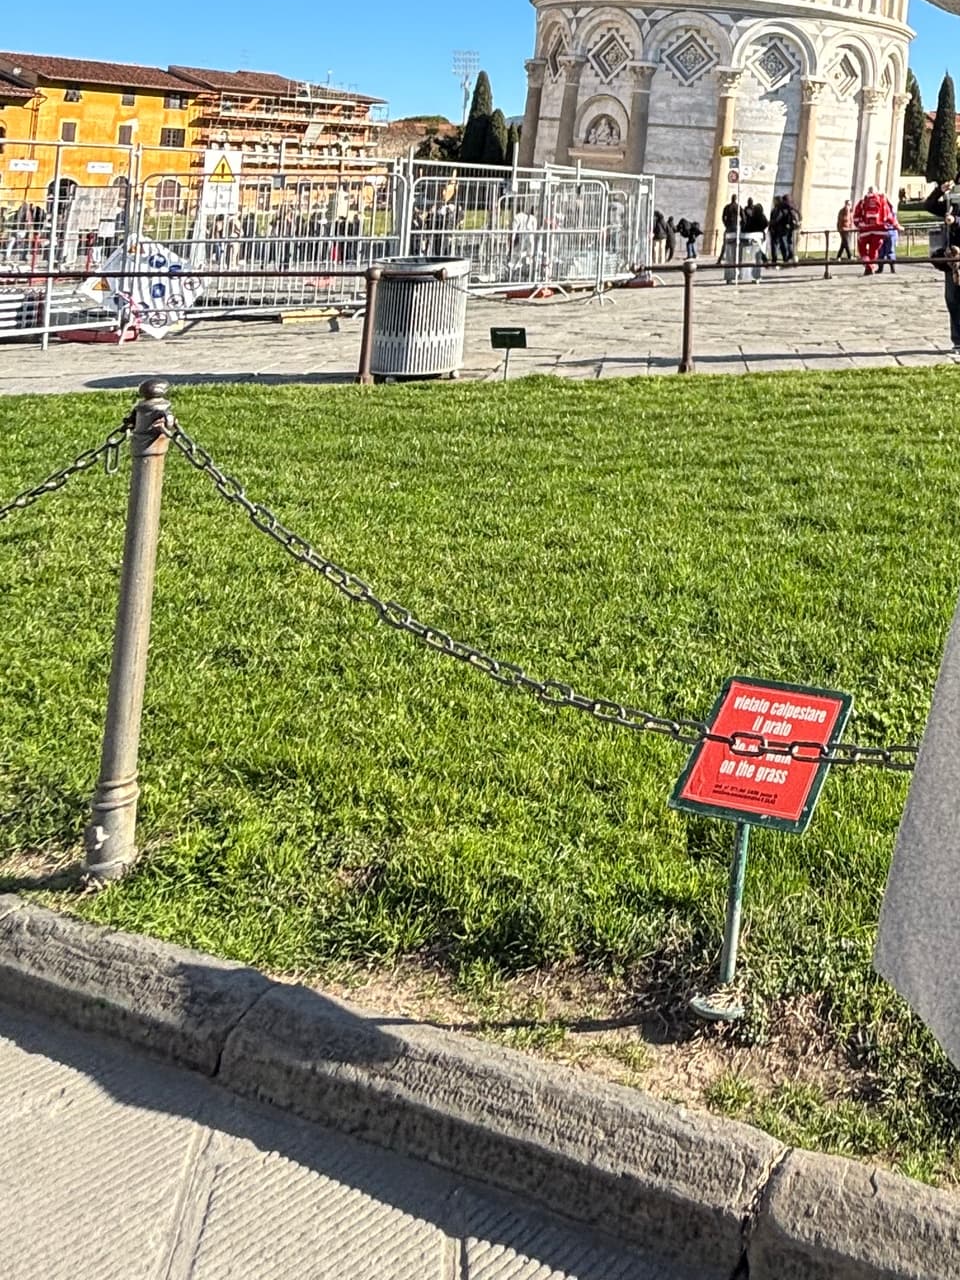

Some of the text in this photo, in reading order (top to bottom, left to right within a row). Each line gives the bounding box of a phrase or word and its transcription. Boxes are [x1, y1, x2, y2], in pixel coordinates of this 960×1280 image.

[734, 695, 827, 723] vietato calpestare
[752, 715, 792, 737] il prato
[720, 759, 788, 784] on the grass
